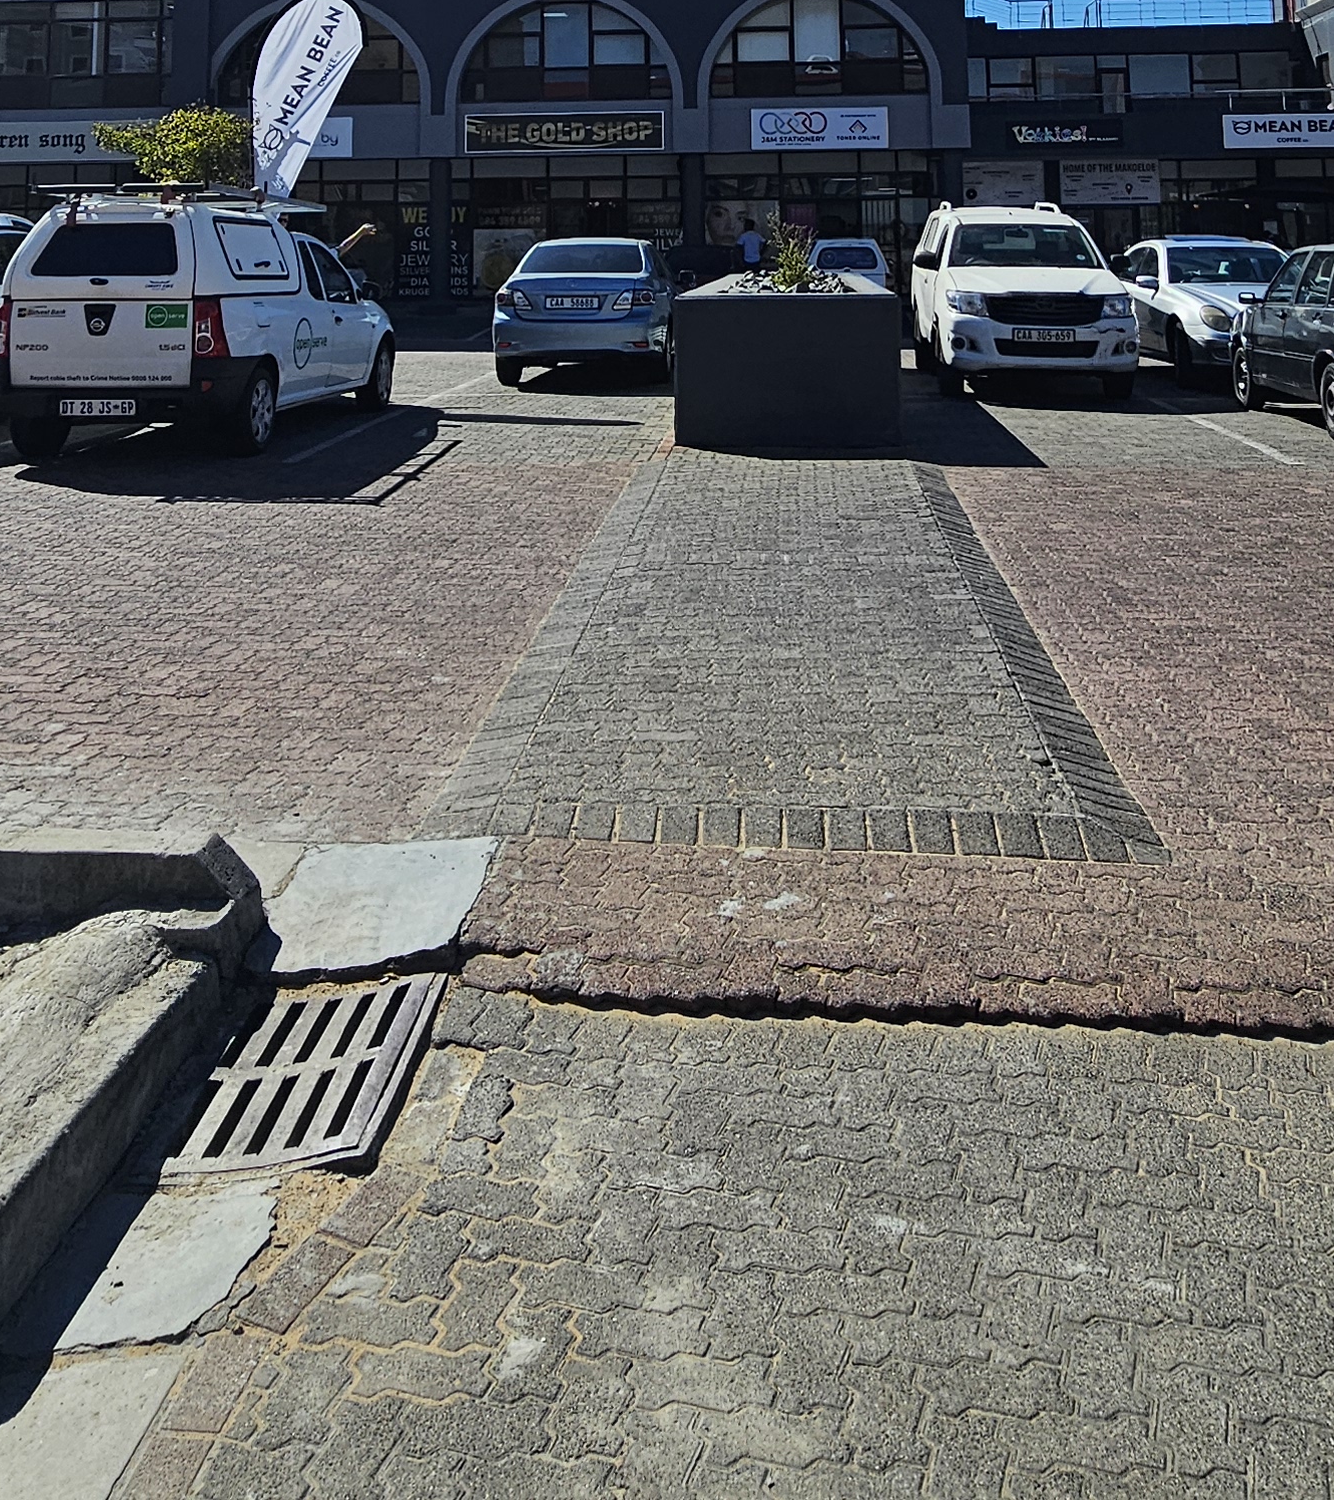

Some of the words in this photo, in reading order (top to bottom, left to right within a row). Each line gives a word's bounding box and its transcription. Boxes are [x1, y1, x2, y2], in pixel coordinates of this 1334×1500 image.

[273, 65, 316, 126] MEAN
[306, 6, 344, 62] BEAN
[477, 123, 520, 143] THE
[525, 122, 586, 143] GOLD
[592, 121, 653, 141] SHOP
[1254, 120, 1302, 133] MEAN
[39, 133, 86, 154] song
[1063, 164, 1084, 173] HOME
[1087, 164, 1097, 173] OF
[1098, 163, 1113, 173] THE
[402, 207, 427, 223] WE
[1016, 330, 1033, 340] CAA
[61, 401, 75, 414] DT
[80, 401, 94, 414] 28
